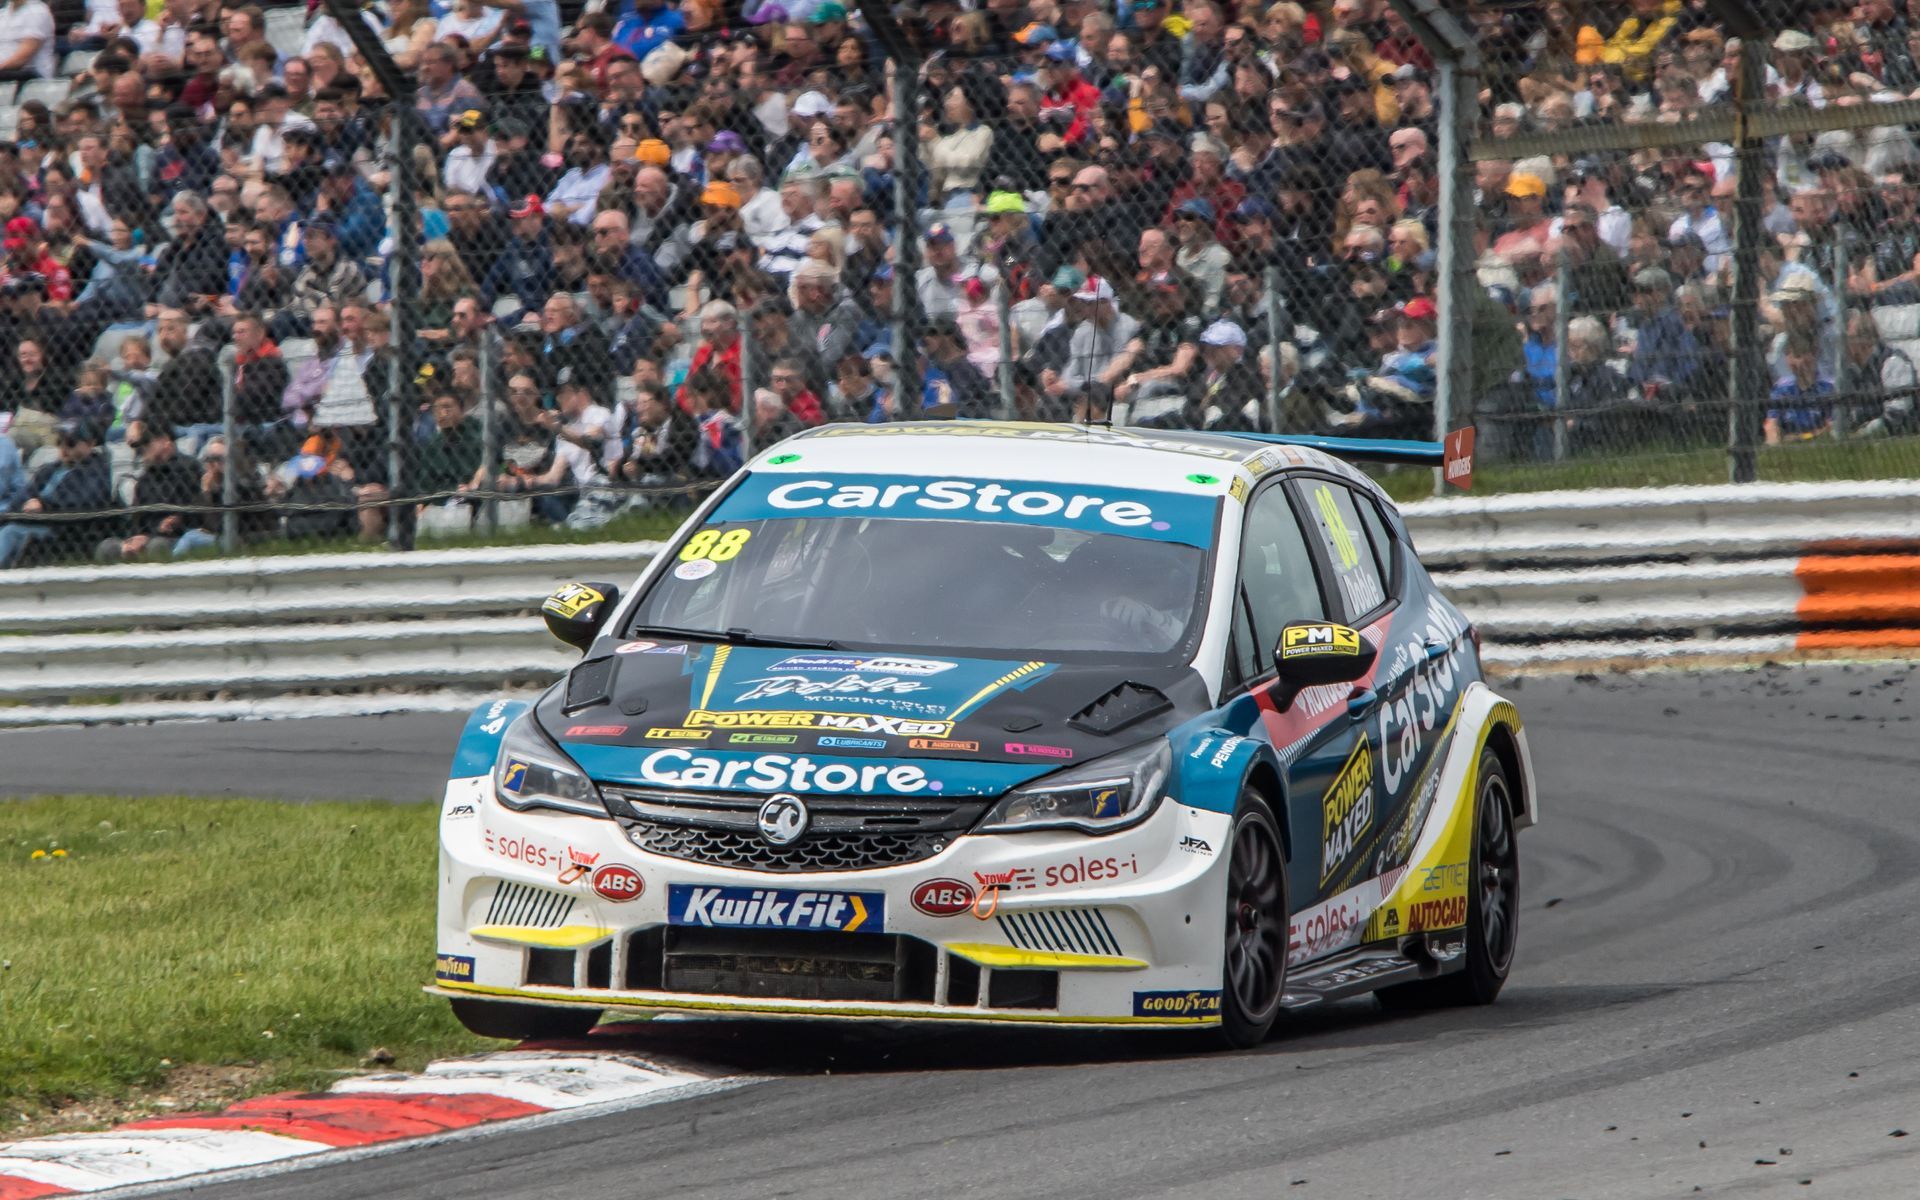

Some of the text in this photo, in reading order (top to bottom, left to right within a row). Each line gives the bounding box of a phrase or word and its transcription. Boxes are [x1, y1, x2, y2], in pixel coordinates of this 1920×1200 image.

[679, 528, 752, 561] 88
[1286, 628, 1356, 647] PMR
[1286, 646, 1310, 657] POWER
[693, 711, 945, 736] POWER MAXED
[836, 738, 884, 748] LUBRICANTS
[1326, 747, 1369, 840] POWER
[448, 805, 475, 816] JFA
[1324, 785, 1372, 877] MAXED
[499, 836, 563, 871] sales-i
[1180, 836, 1212, 852] JFA
[984, 873, 1006, 884] TOW
[1045, 853, 1138, 887] sales-i
[599, 874, 639, 893] ABS
[922, 884, 966, 905] ABS
[682, 888, 848, 928] KwikFit
[1408, 896, 1466, 932] AUTOCAR
[1306, 896, 1359, 946] sales-i
